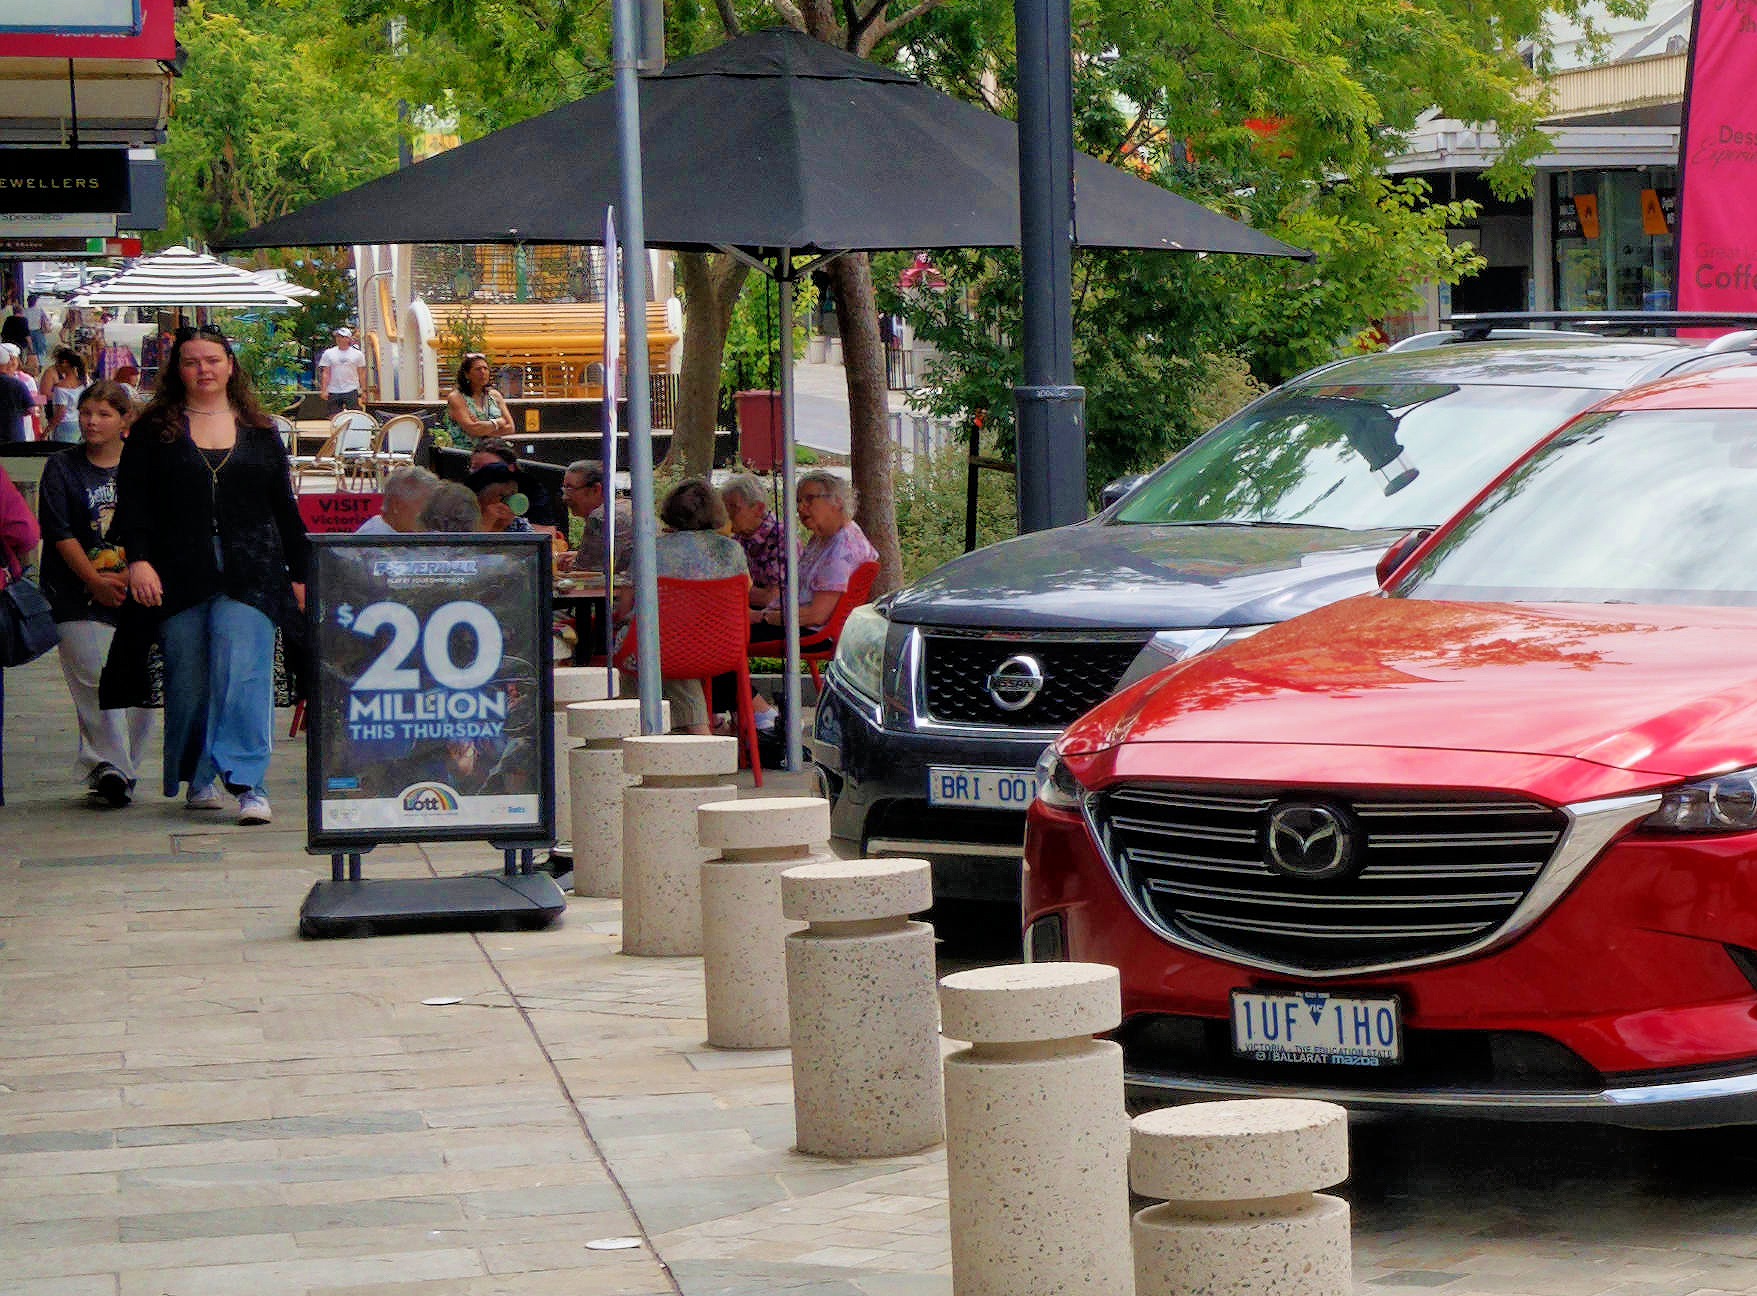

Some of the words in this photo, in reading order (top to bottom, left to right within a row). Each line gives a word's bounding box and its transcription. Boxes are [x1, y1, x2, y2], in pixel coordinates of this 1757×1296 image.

[0, 178, 99, 189] EWELLERS
[319, 498, 372, 512] VISIT
[337, 600, 504, 691] $20
[349, 690, 506, 723] MILLION
[350, 723, 396, 740] THIS
[401, 722, 504, 739] THURSDAY
[1272, 1052, 1329, 1064] BALLARAT
